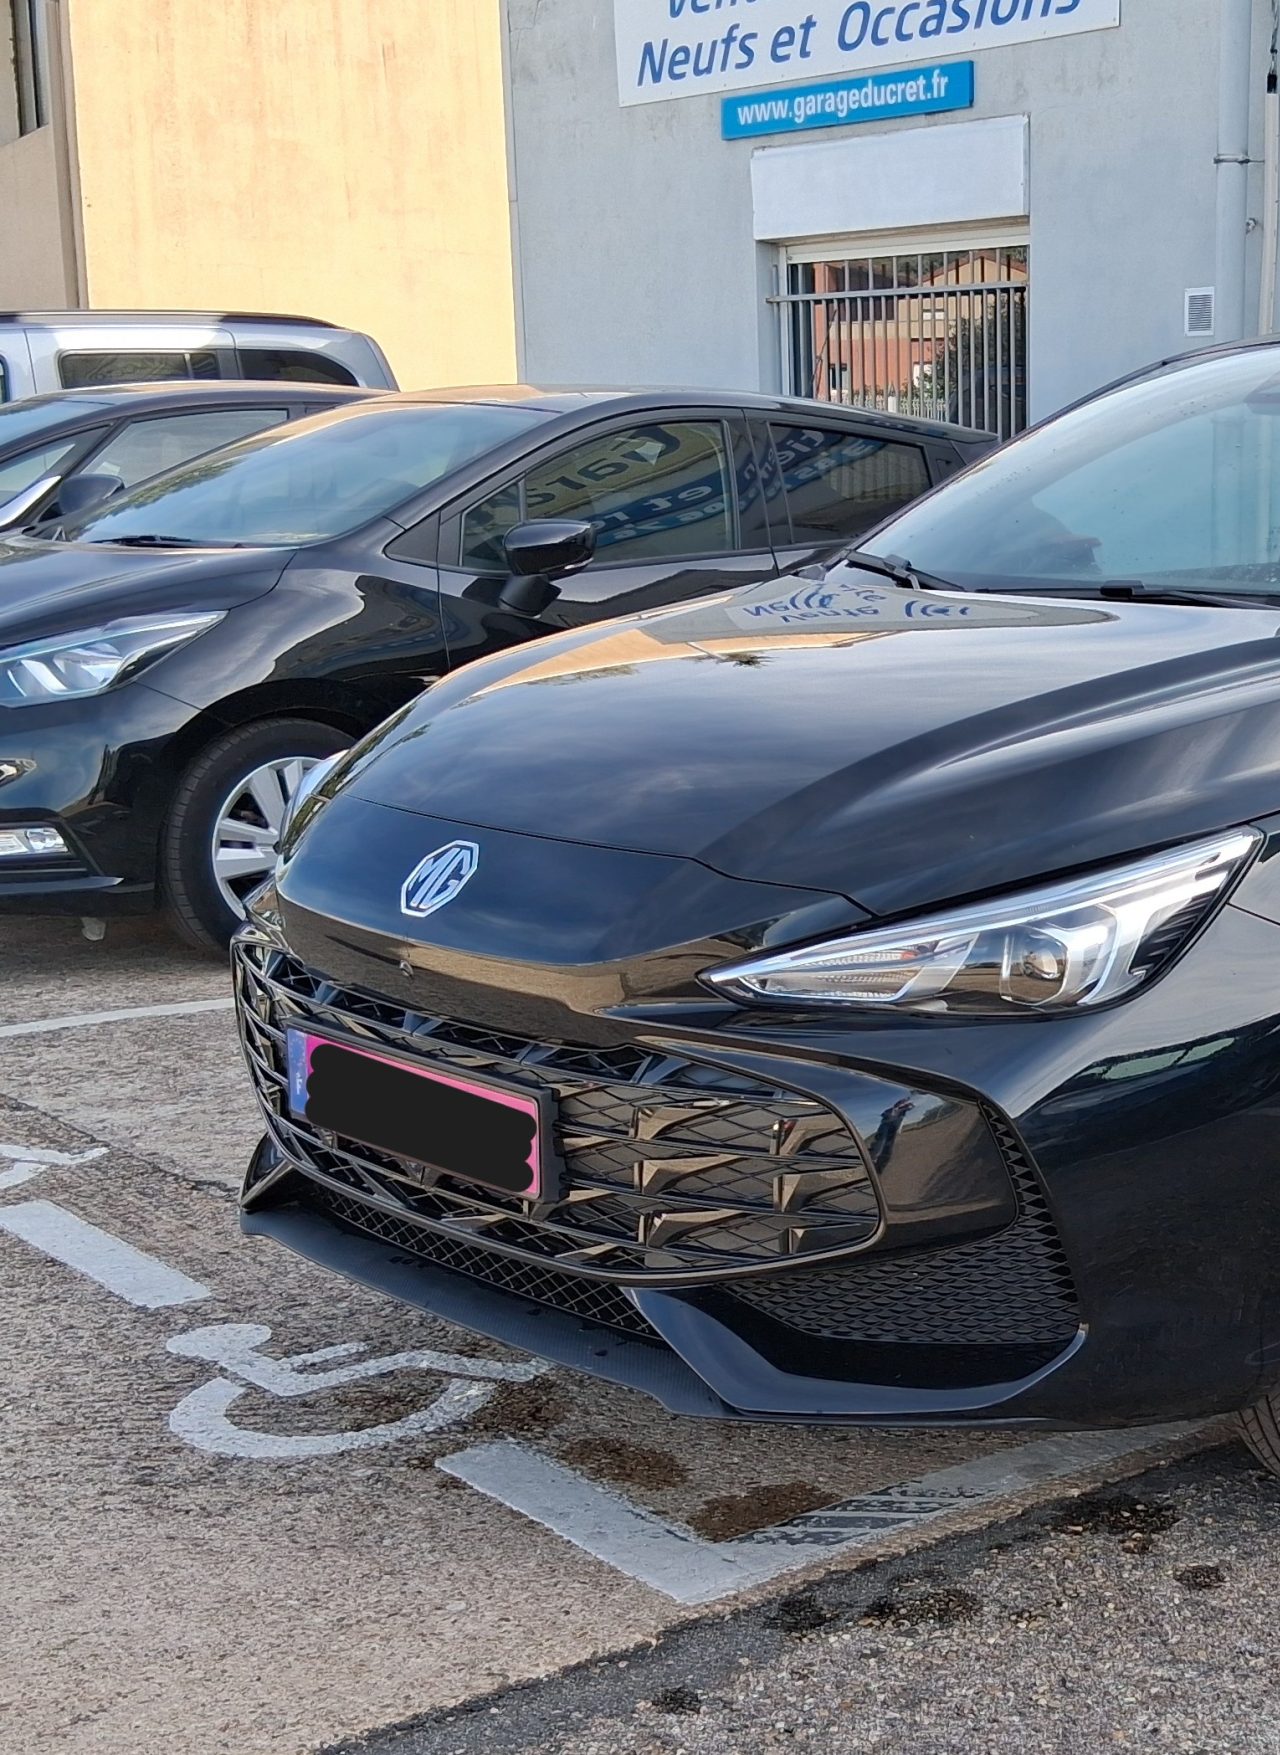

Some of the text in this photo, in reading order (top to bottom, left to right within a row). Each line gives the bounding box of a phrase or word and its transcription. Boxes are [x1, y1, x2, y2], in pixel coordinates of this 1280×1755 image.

[637, 23, 758, 87] Neufs
[769, 14, 817, 63] et
[736, 68, 949, 126] www.garageducret.fr
[406, 845, 473, 910] MG
